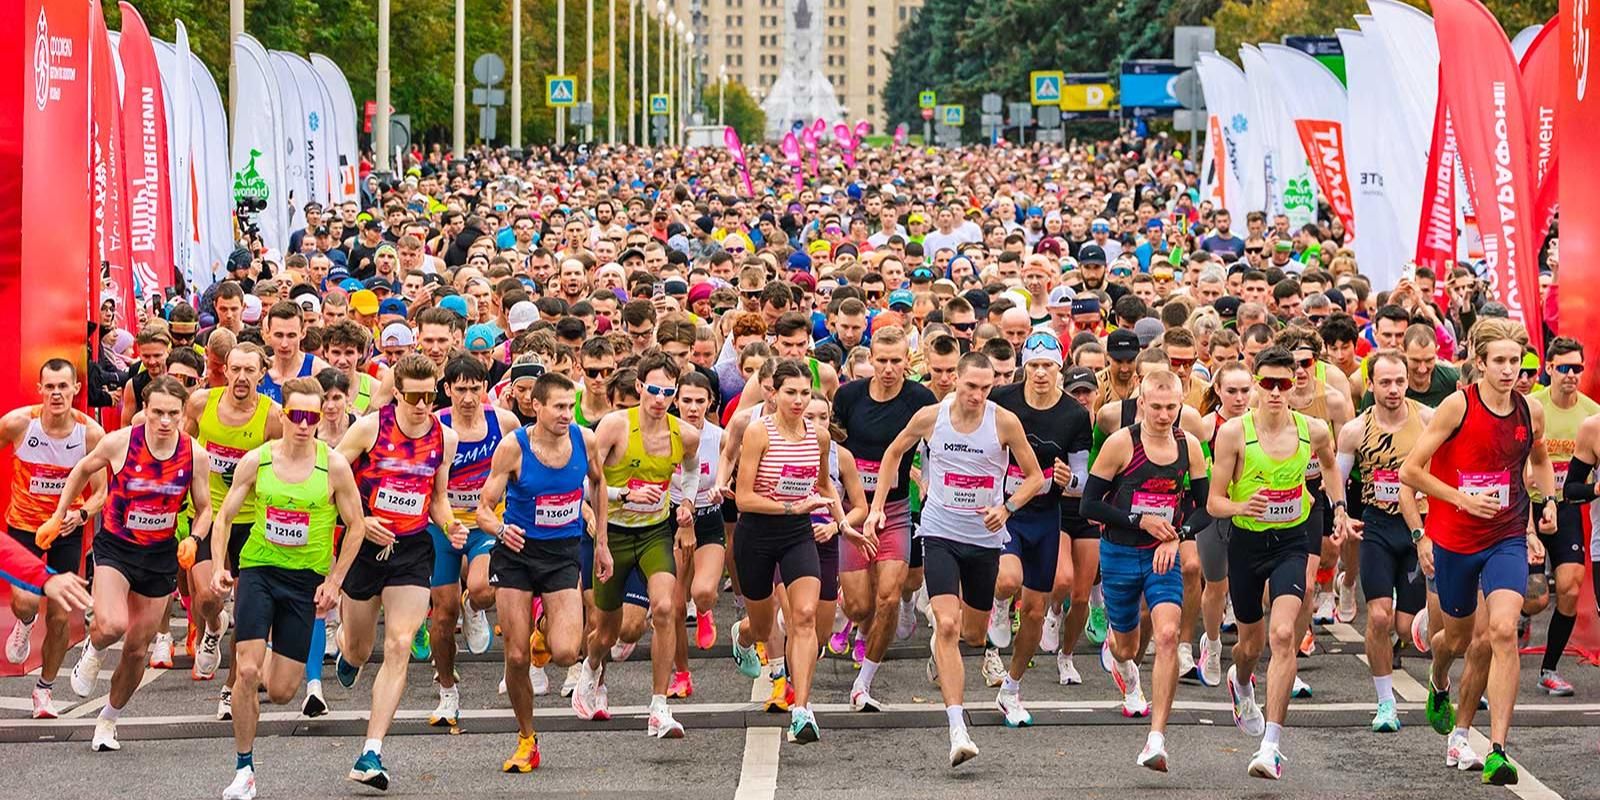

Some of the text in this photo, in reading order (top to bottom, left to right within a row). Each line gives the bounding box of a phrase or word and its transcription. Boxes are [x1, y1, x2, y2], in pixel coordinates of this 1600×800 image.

[1087, 87, 1104, 105] D
[954, 490, 976, 498] ШАРОВ
[1385, 486, 1400, 494] 127
[387, 494, 418, 508] 12649
[954, 496, 976, 504] СЕРГЕЙ
[1269, 505, 1294, 515] 12116
[138, 516, 167, 526] 12604
[274, 526, 303, 539] 12146
